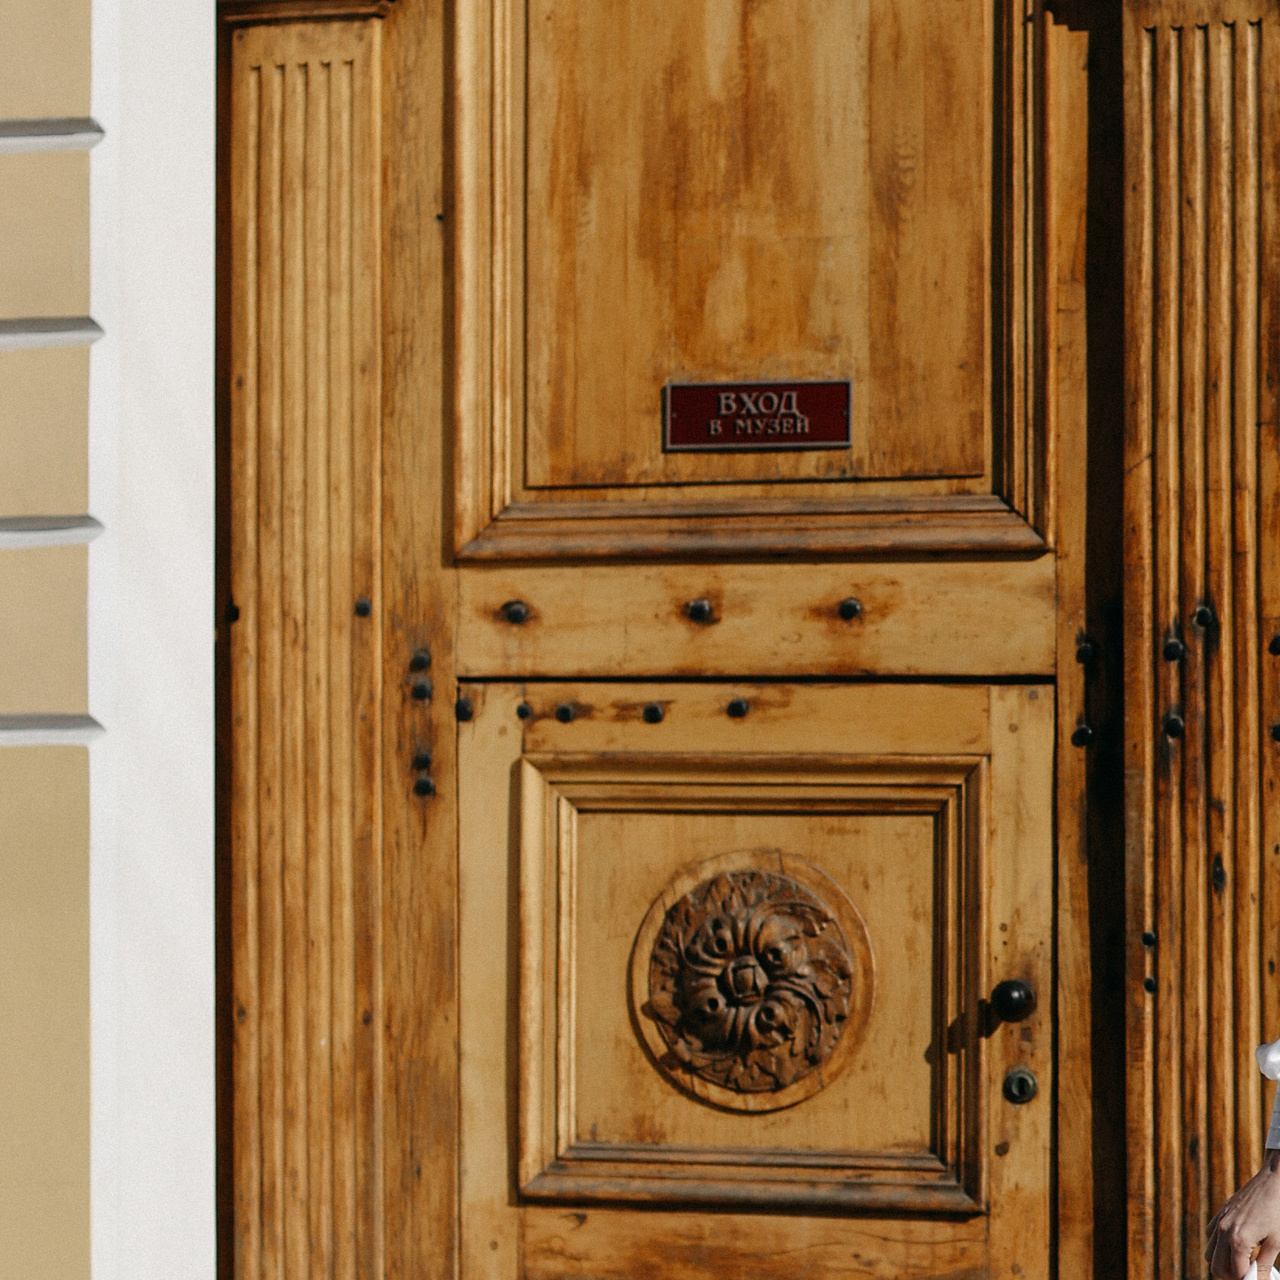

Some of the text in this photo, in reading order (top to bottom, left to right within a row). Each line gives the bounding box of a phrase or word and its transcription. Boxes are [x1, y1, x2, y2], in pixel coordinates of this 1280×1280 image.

[719, 391, 801, 418] ВХОД
[710, 416, 810, 435] В МУЗЕЙ
